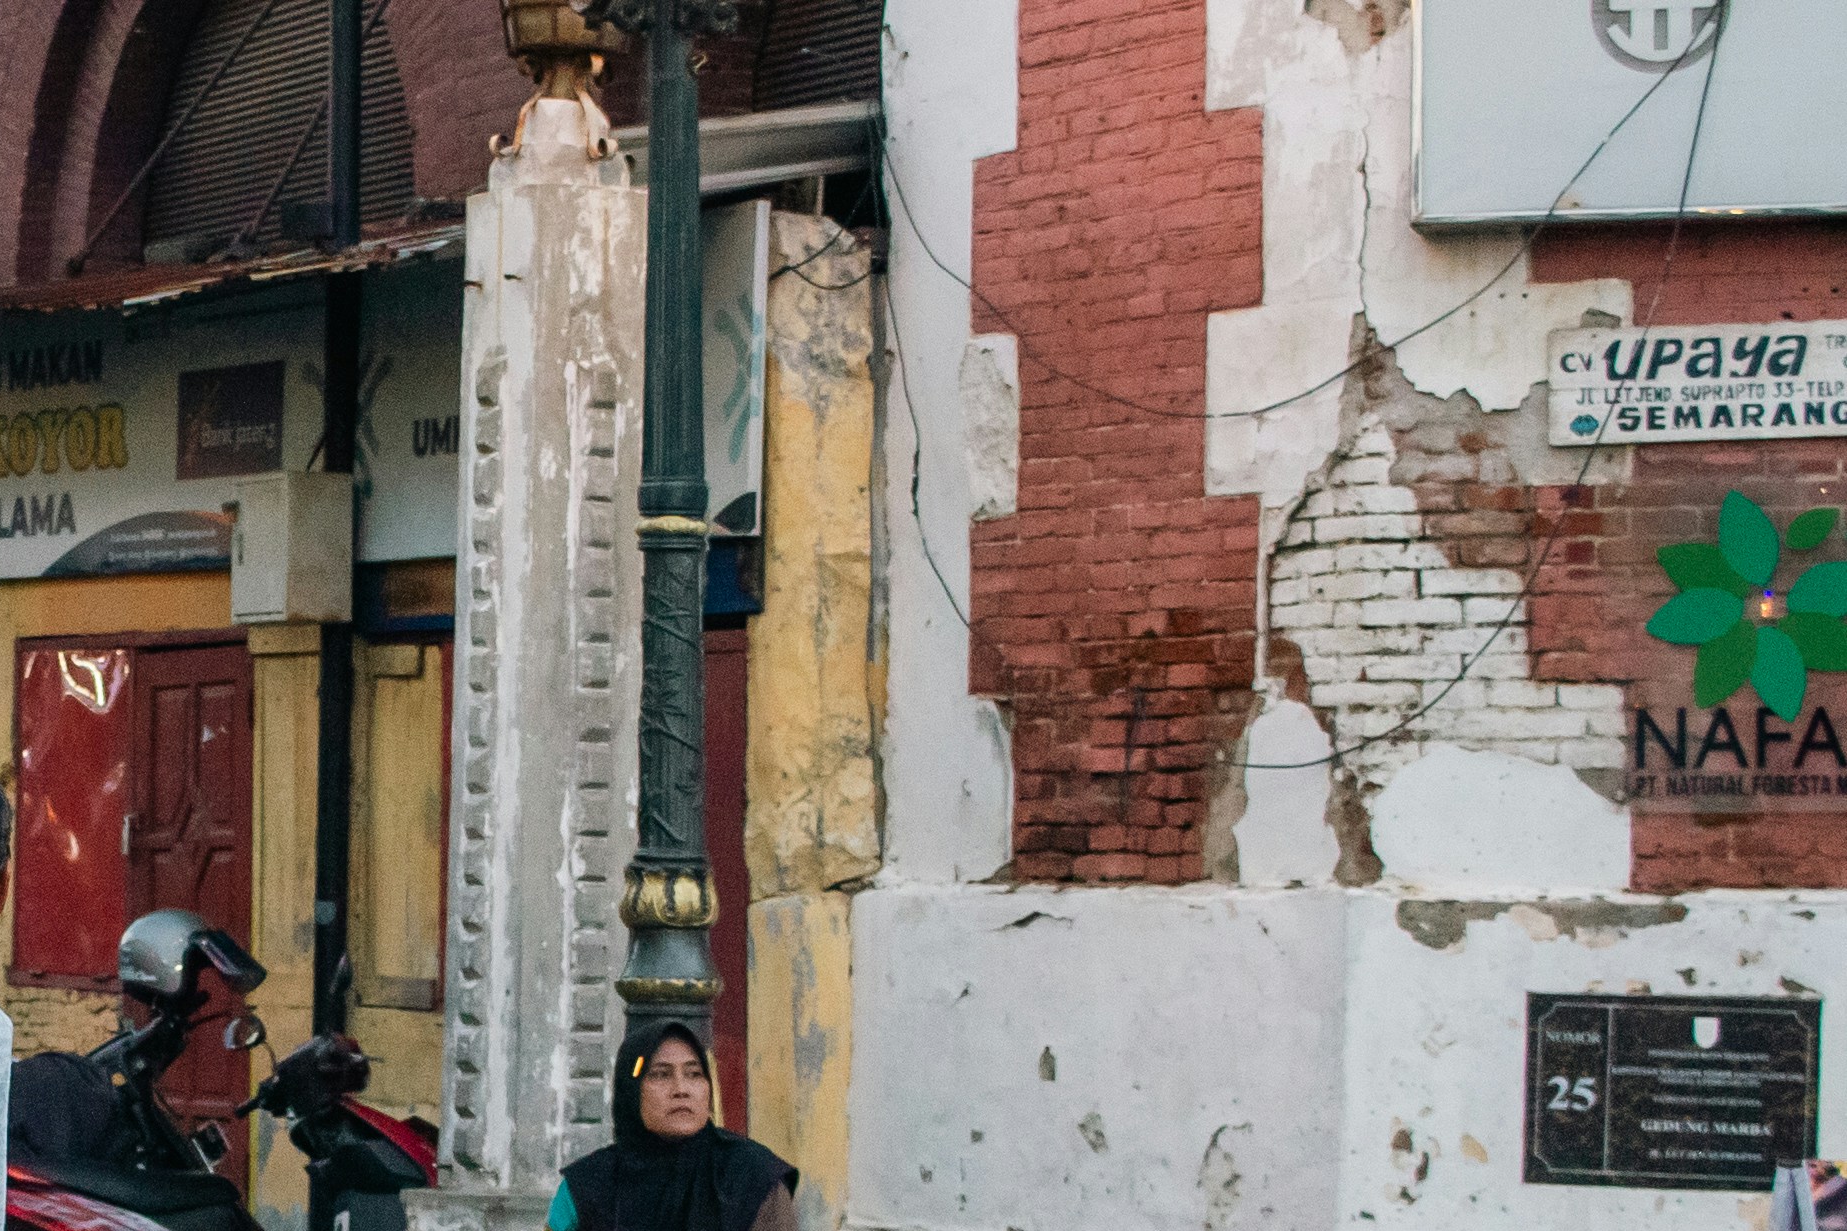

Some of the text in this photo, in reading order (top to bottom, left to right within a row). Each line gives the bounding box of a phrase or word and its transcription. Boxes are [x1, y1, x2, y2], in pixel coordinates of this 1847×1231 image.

[8, 341, 104, 391] MAKAN
[1616, 401, 1847, 432] SEMARANG
[1546, 1075, 1598, 1112] 25
